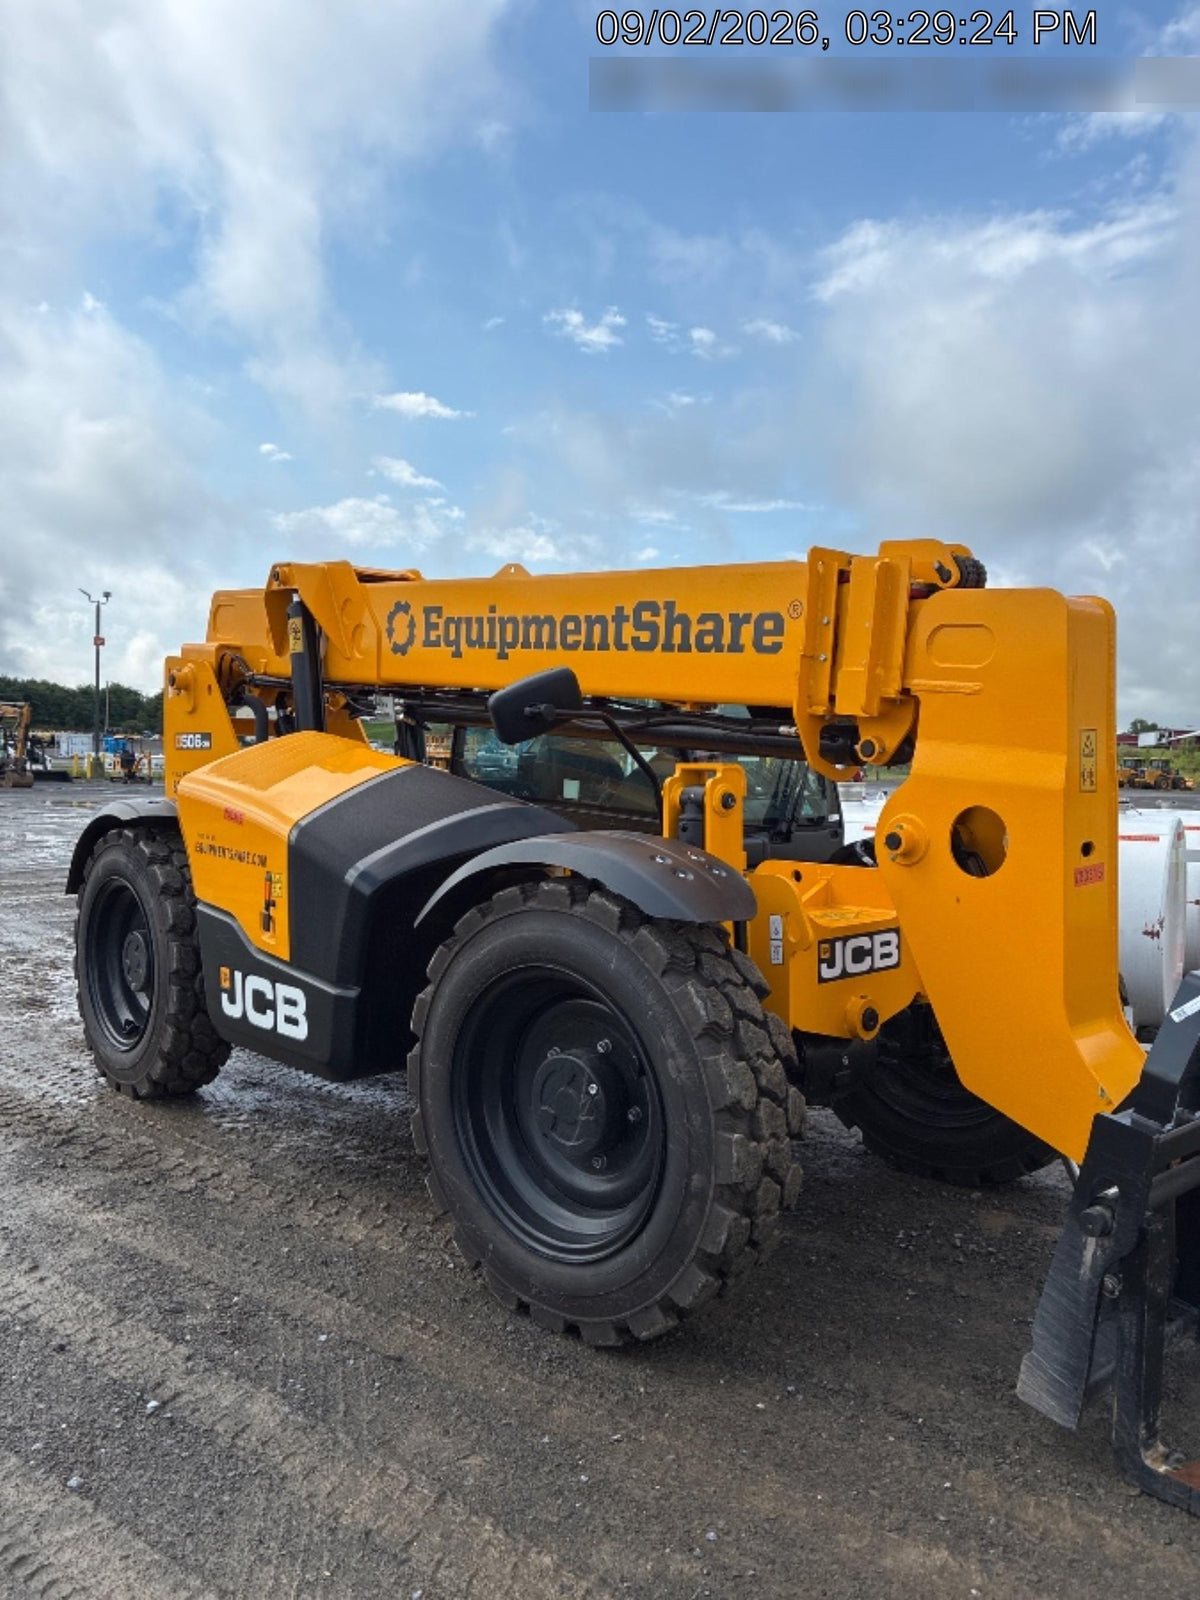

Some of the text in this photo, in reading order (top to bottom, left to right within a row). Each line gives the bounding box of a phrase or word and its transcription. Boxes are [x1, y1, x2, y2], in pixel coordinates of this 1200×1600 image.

[422, 601, 785, 660] EquipmentShare
[820, 931, 899, 979] JCB
[221, 970, 308, 1041] JCB
